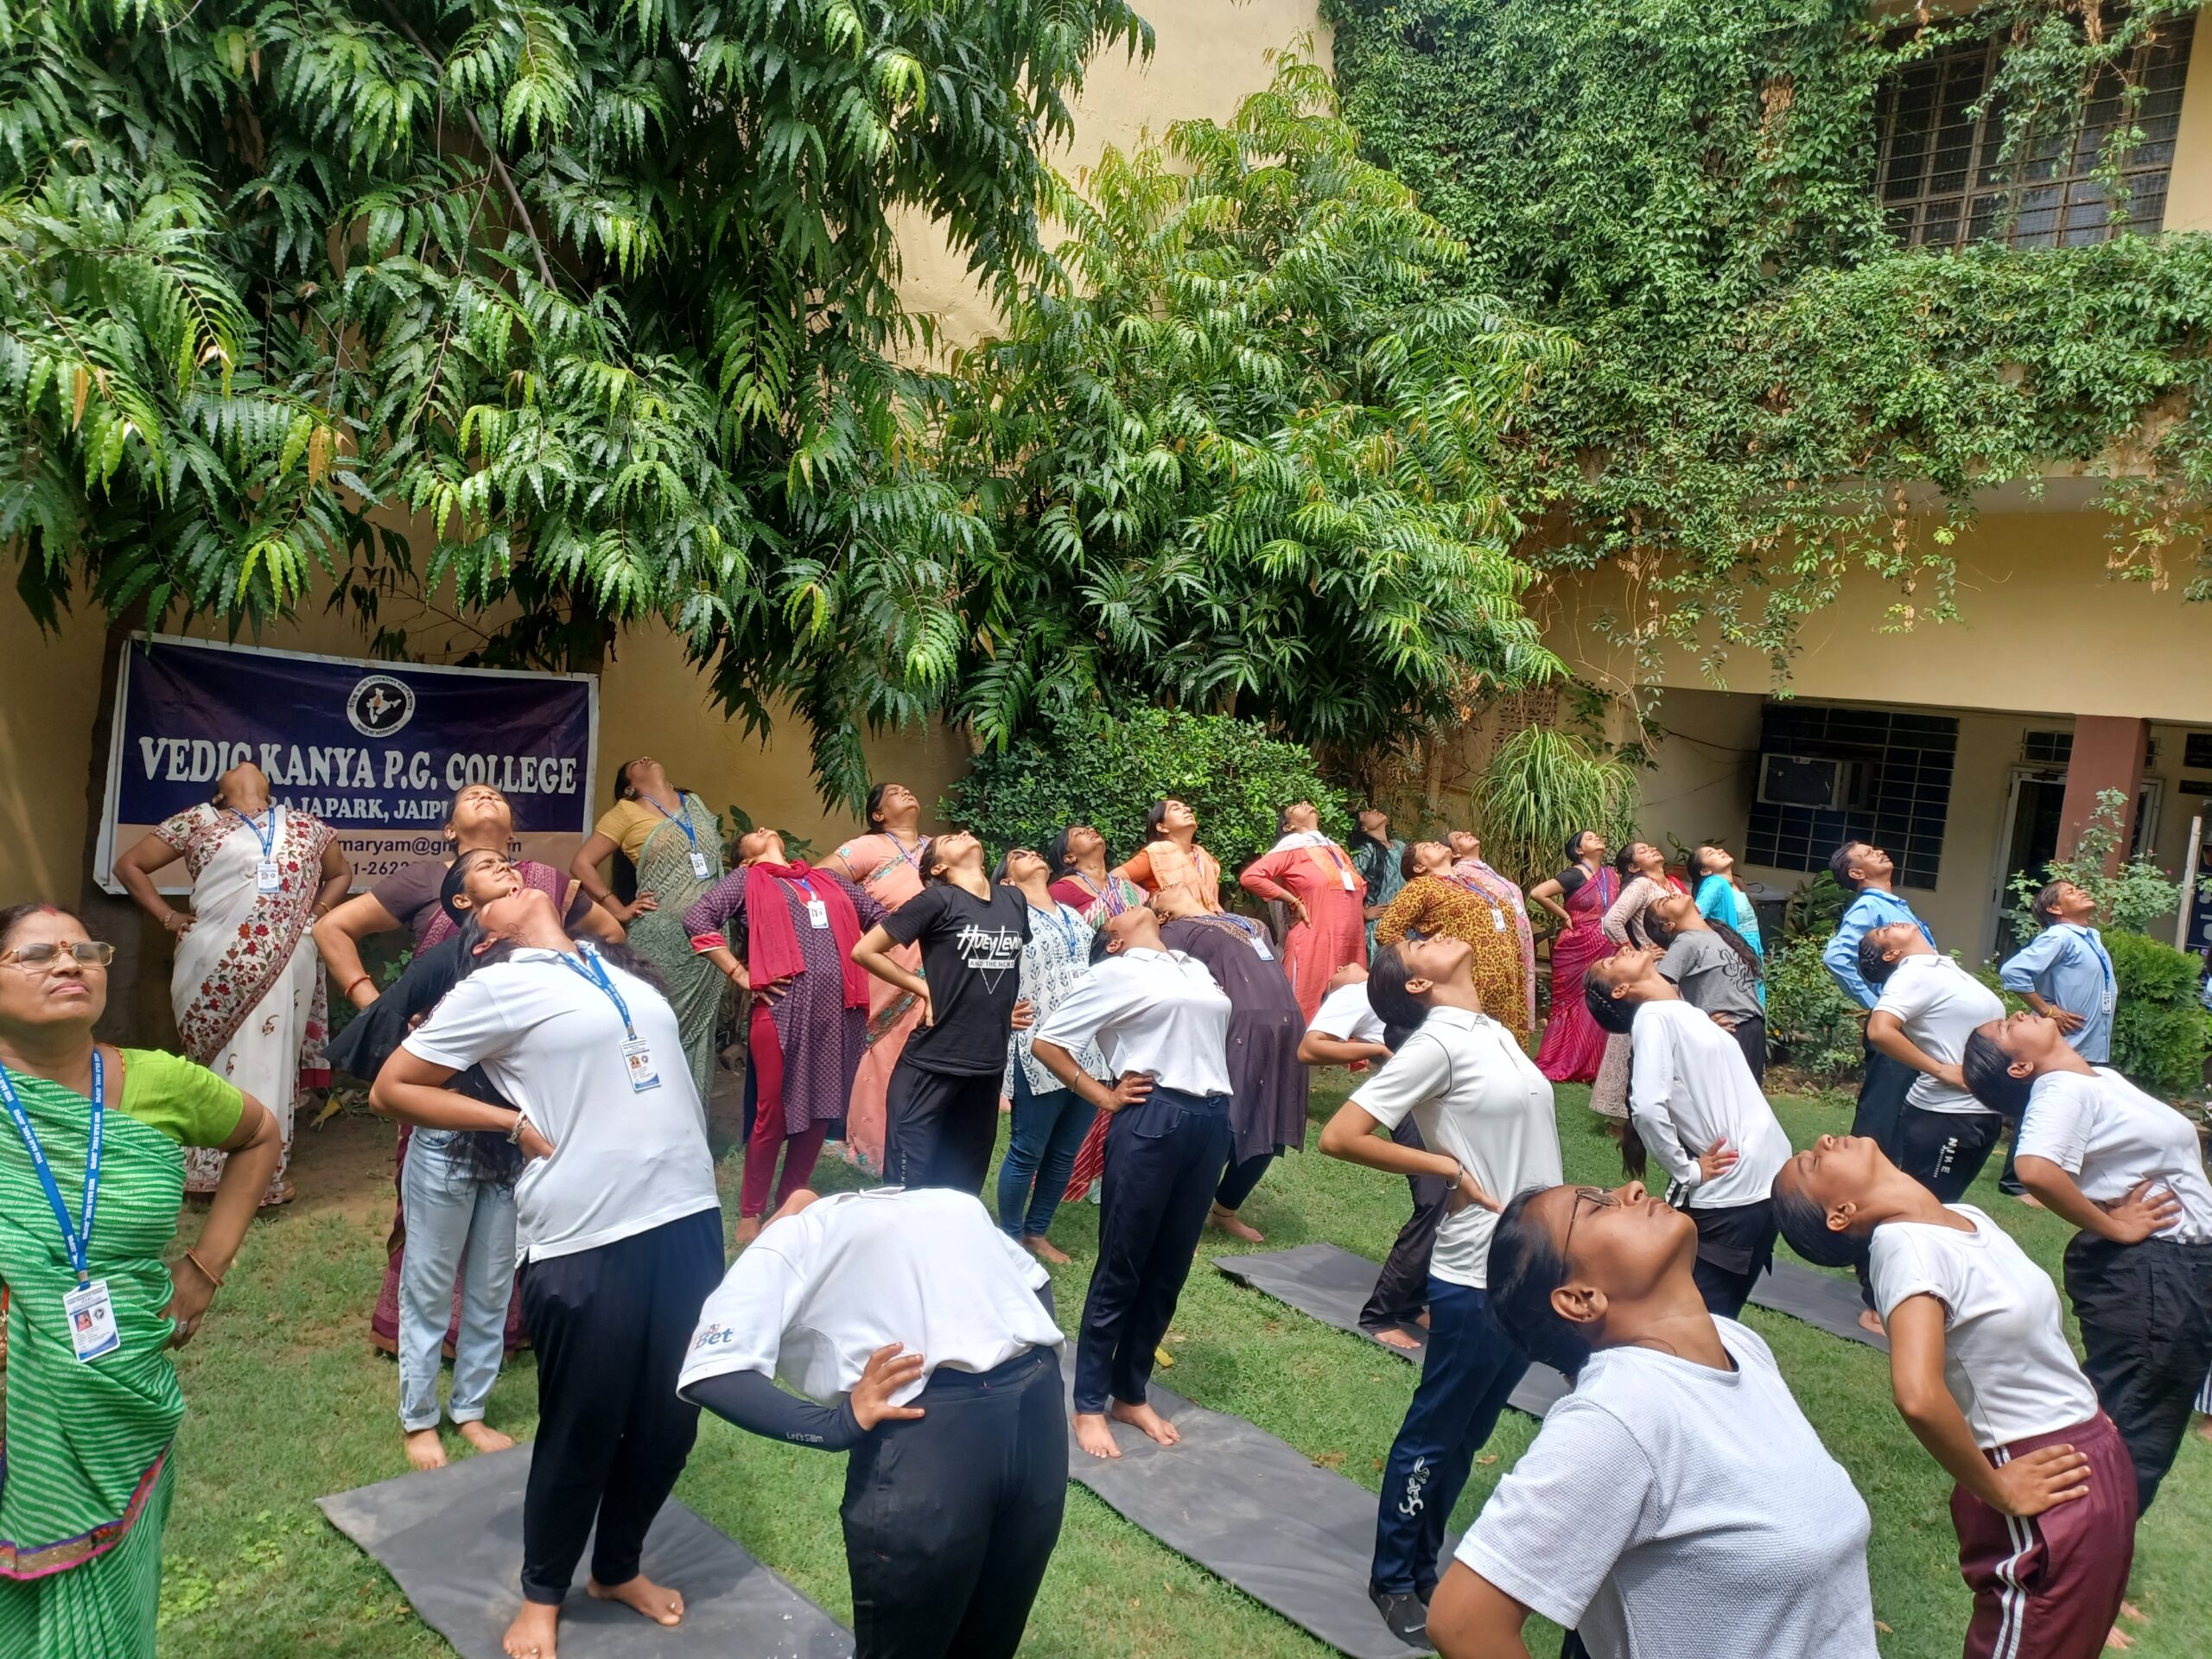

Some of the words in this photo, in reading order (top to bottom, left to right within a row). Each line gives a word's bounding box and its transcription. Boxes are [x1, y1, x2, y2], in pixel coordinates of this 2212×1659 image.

[259, 743, 376, 788] KANYA
[383, 750, 438, 791] P.G.
[446, 753, 577, 795] COLLEGE
[1940, 1137, 1958, 1174] NIKE
